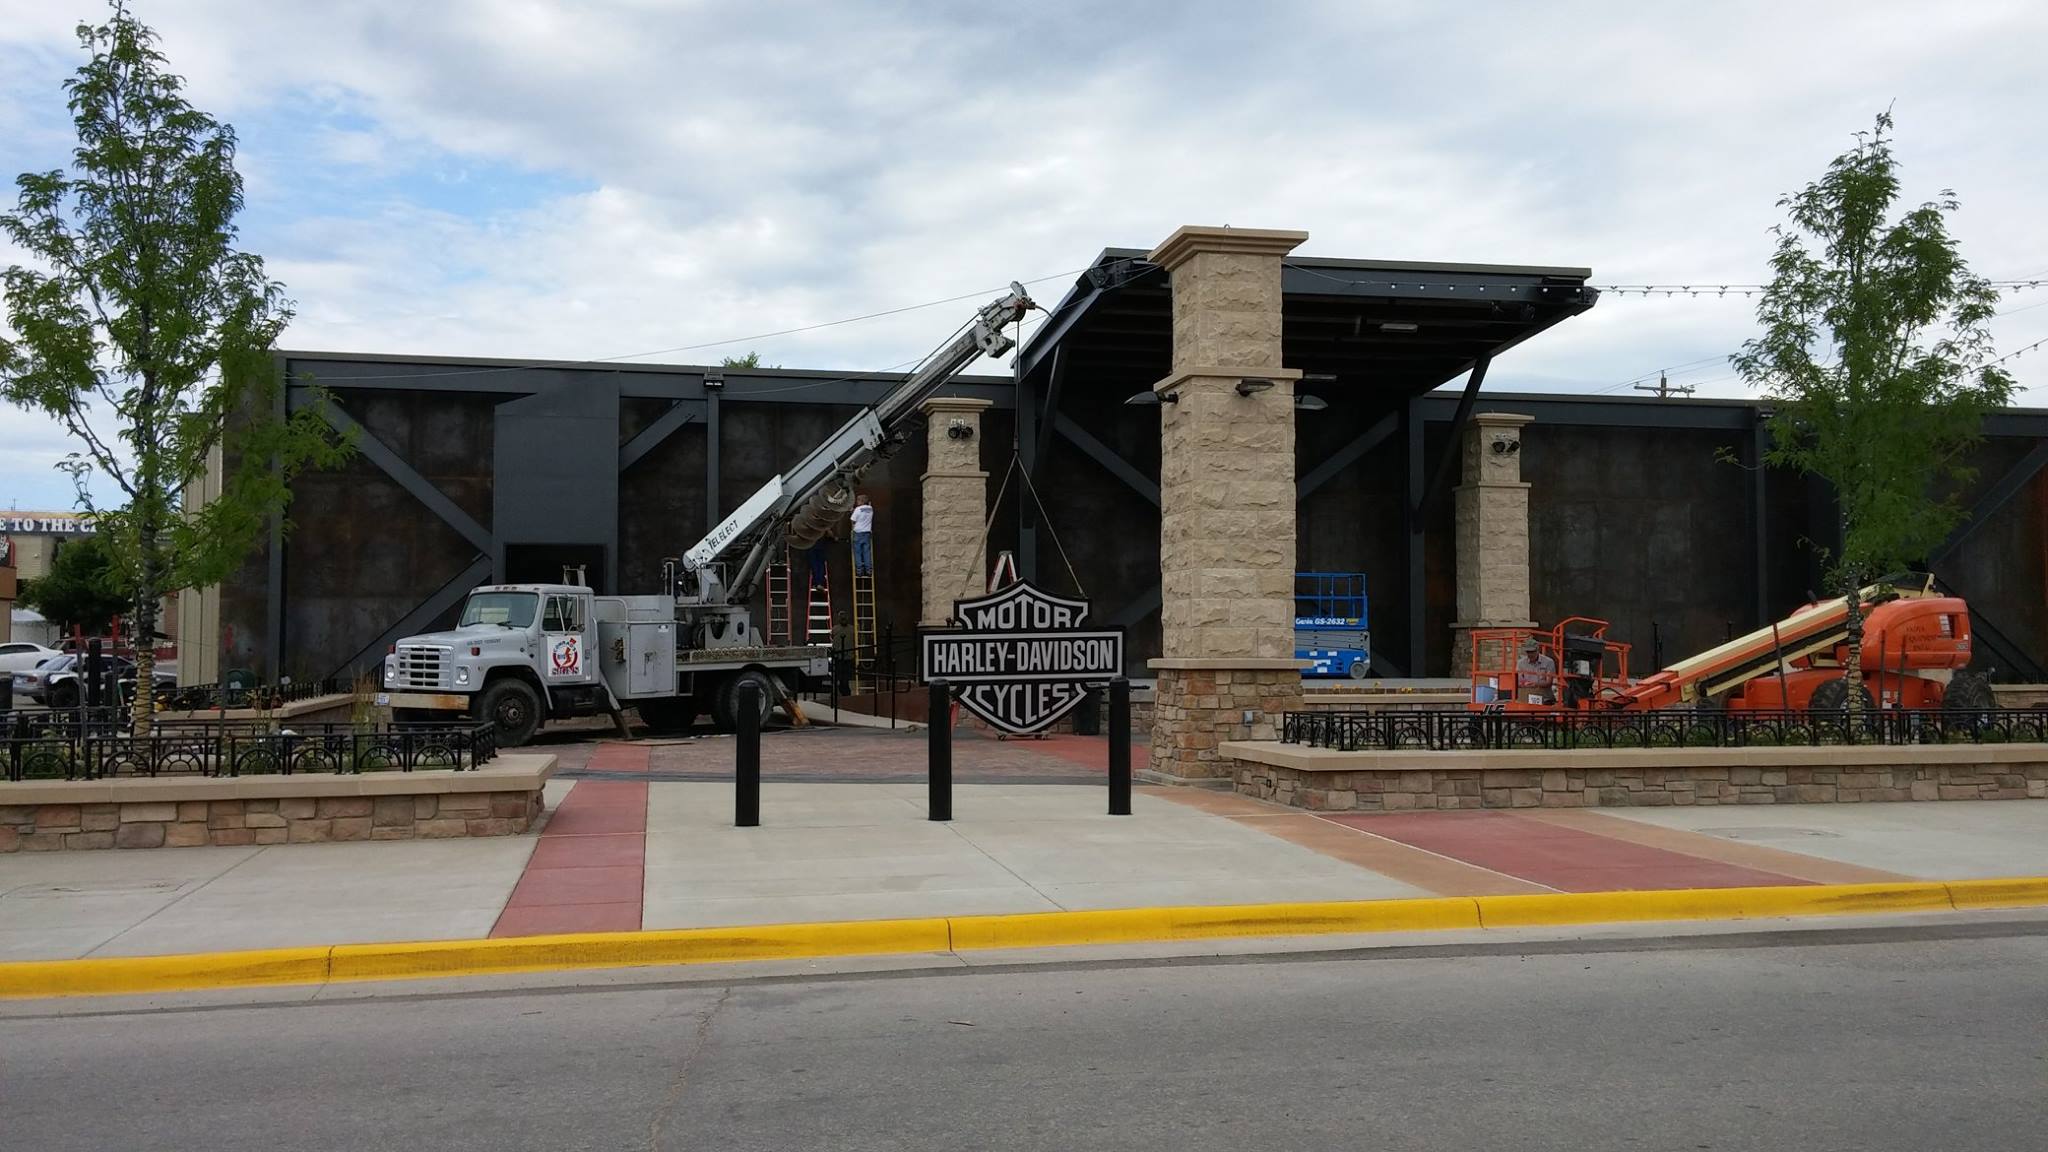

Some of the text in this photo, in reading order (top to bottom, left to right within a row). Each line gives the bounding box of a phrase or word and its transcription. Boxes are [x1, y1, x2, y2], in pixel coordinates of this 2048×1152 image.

[12, 518, 34, 531] TO
[40, 518, 74, 532] THE
[708, 520, 739, 549] TELELECT
[977, 593, 1071, 630] MOTOR
[933, 640, 1113, 673] HARLEY-DAVIDSON
[975, 682, 1070, 726] CYCLES
